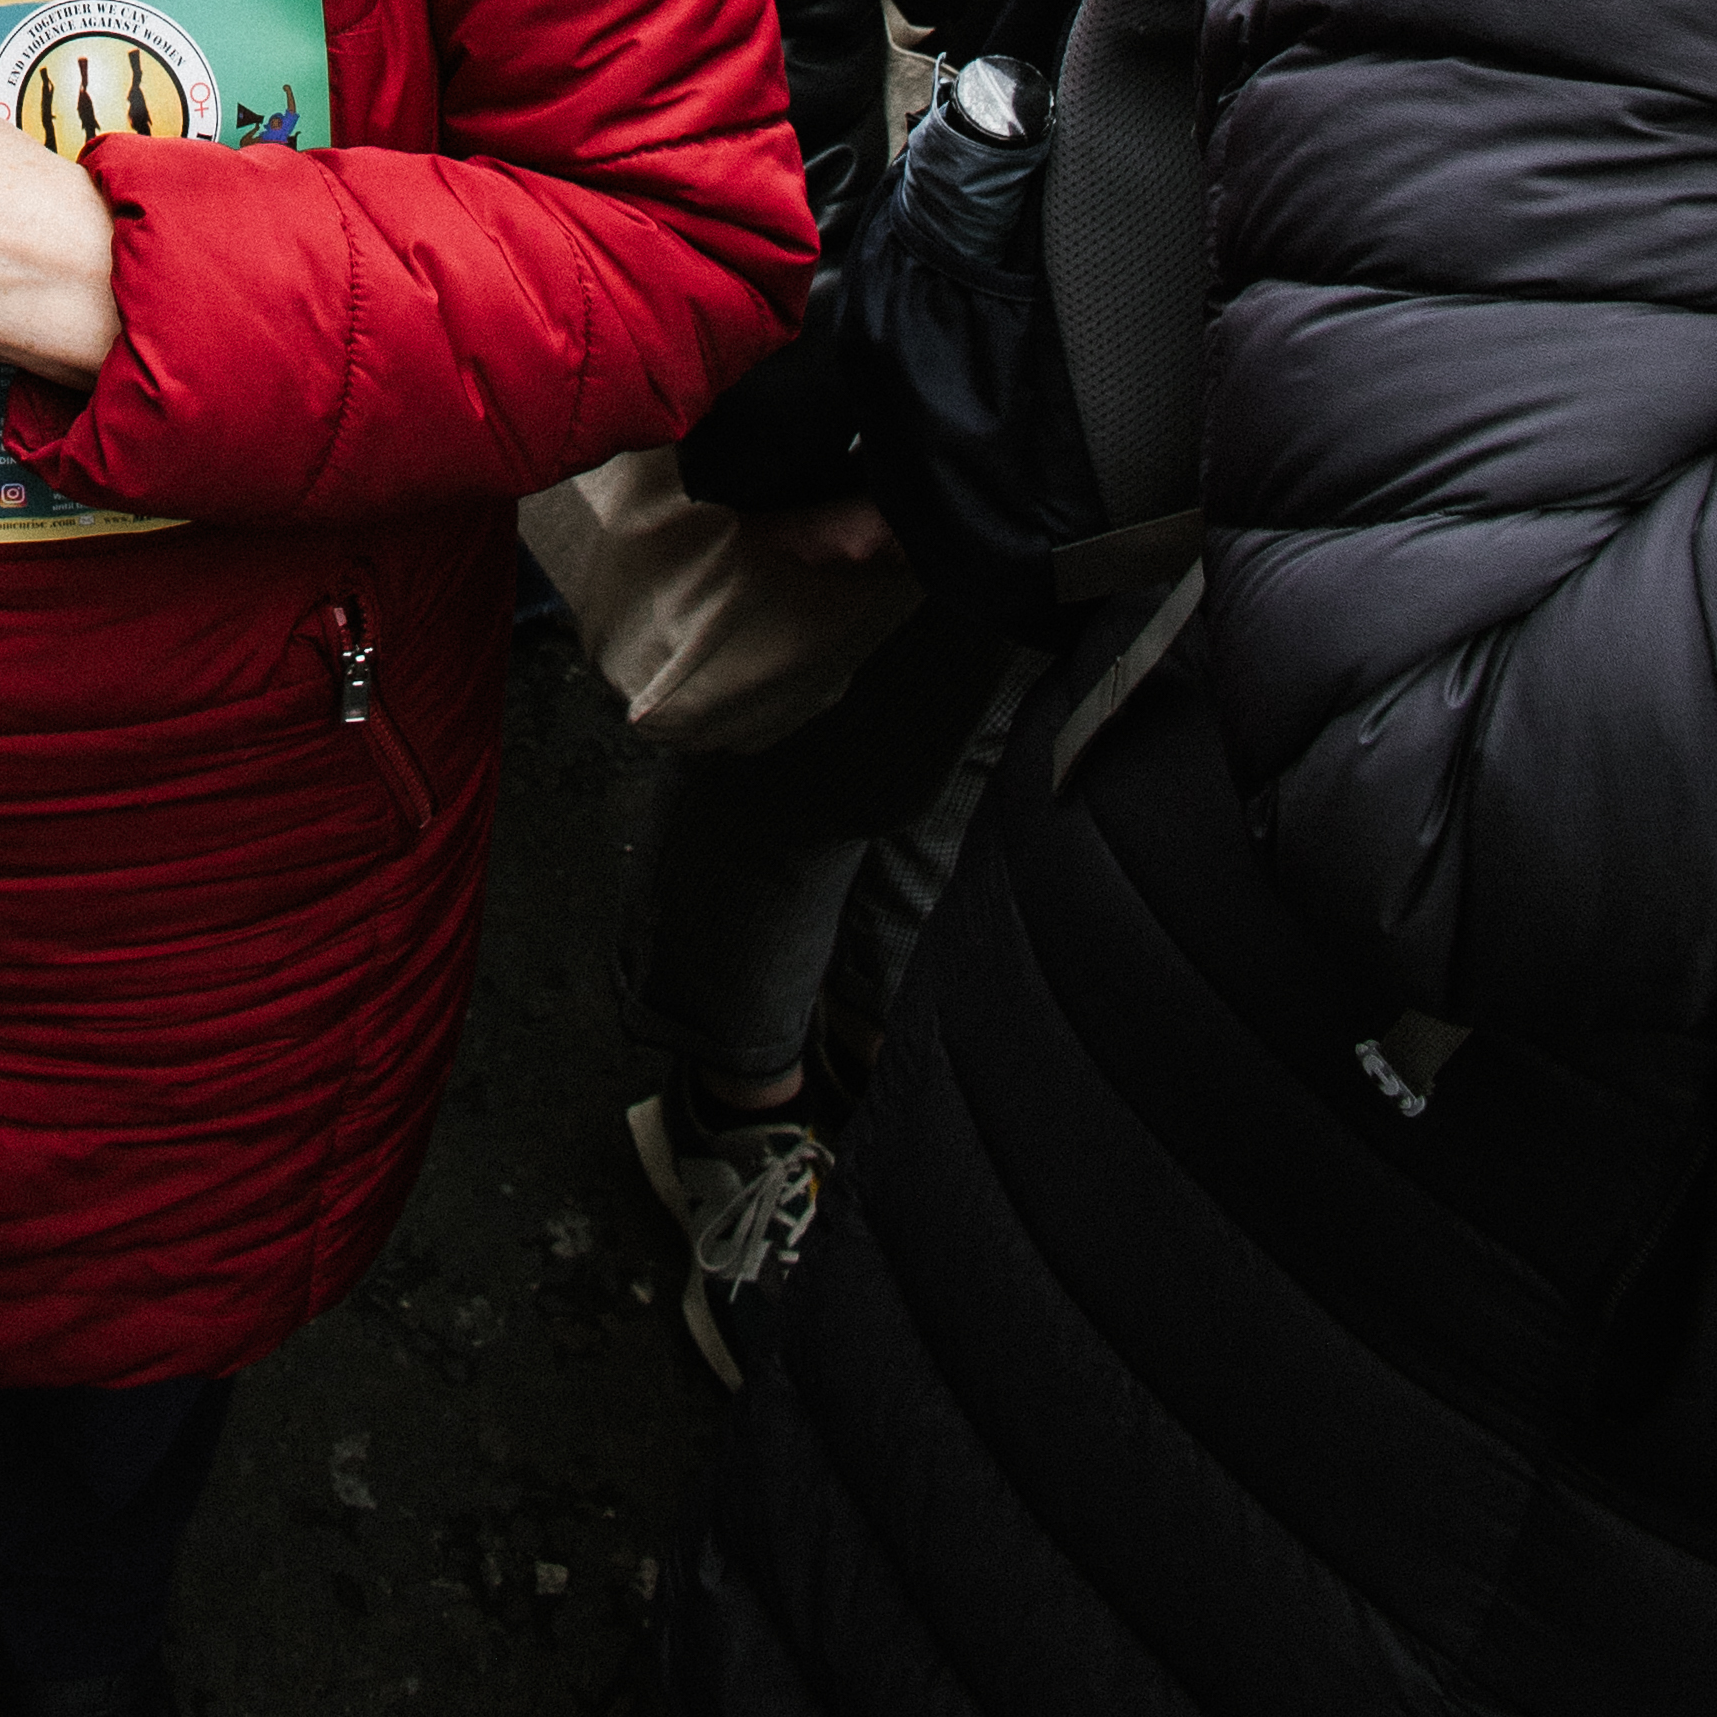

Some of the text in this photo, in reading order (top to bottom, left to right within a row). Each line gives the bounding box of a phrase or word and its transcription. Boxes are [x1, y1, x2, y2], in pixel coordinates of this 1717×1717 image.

[27, 2, 148, 39] TOGETHER WE CAN
[7, 17, 186, 87] END VIOLENCE AGAINST WOMEN
